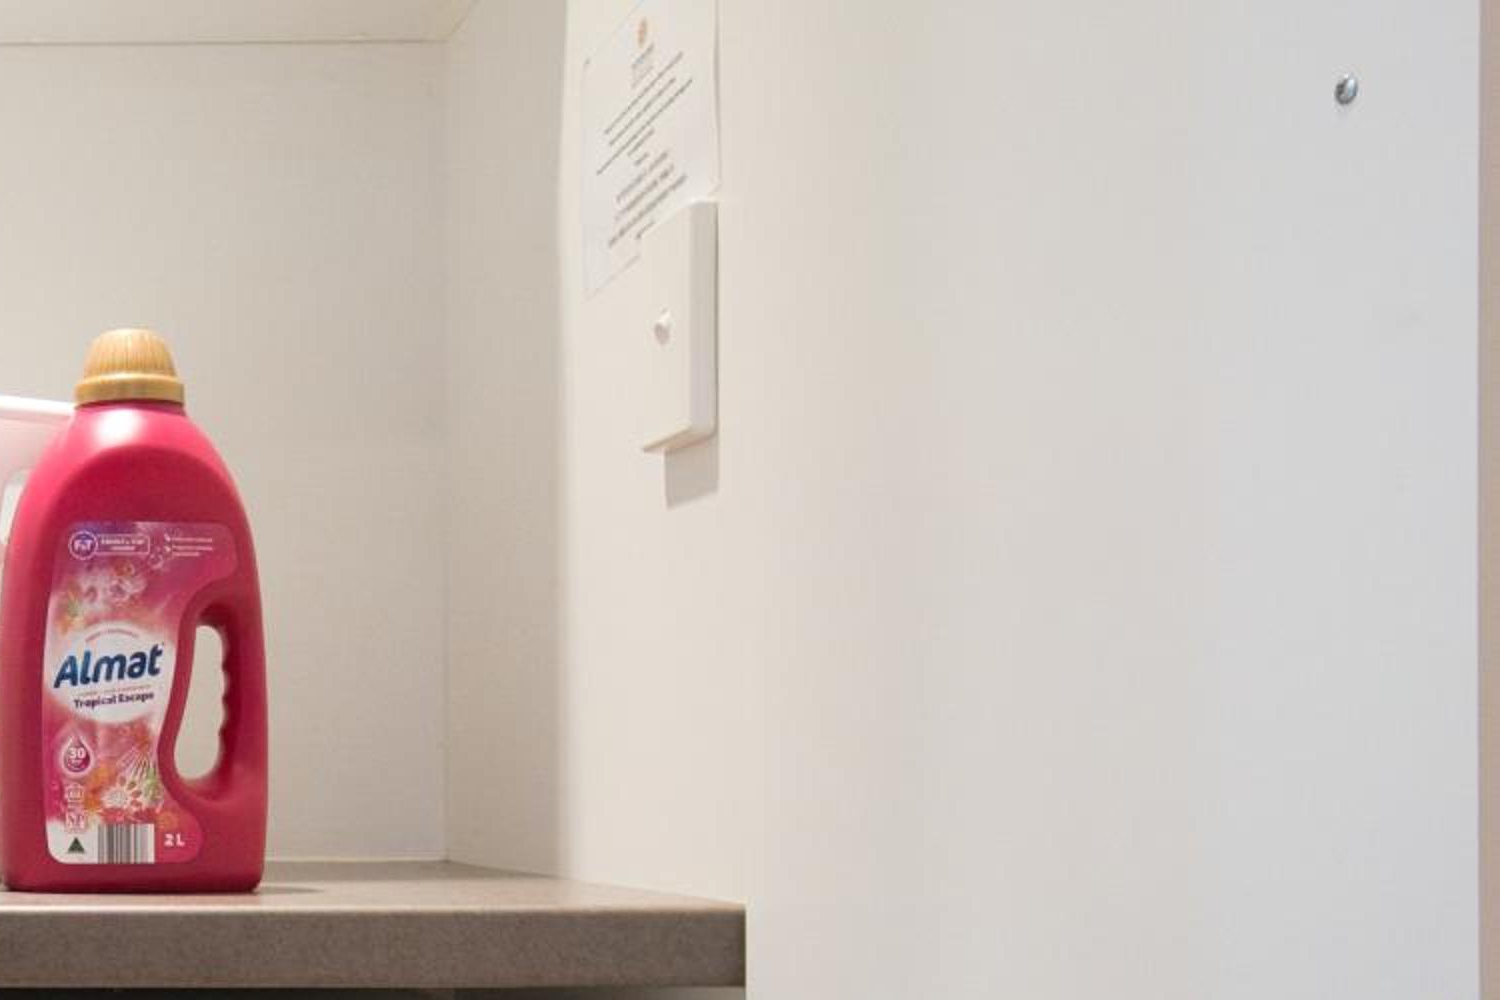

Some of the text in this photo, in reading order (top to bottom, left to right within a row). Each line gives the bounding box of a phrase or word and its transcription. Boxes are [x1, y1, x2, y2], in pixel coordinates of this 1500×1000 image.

[53, 643, 162, 688] Almat
[74, 692, 154, 709] Tropical Escape
[68, 747, 87, 759] 30
[164, 833, 185, 847] 2 L
